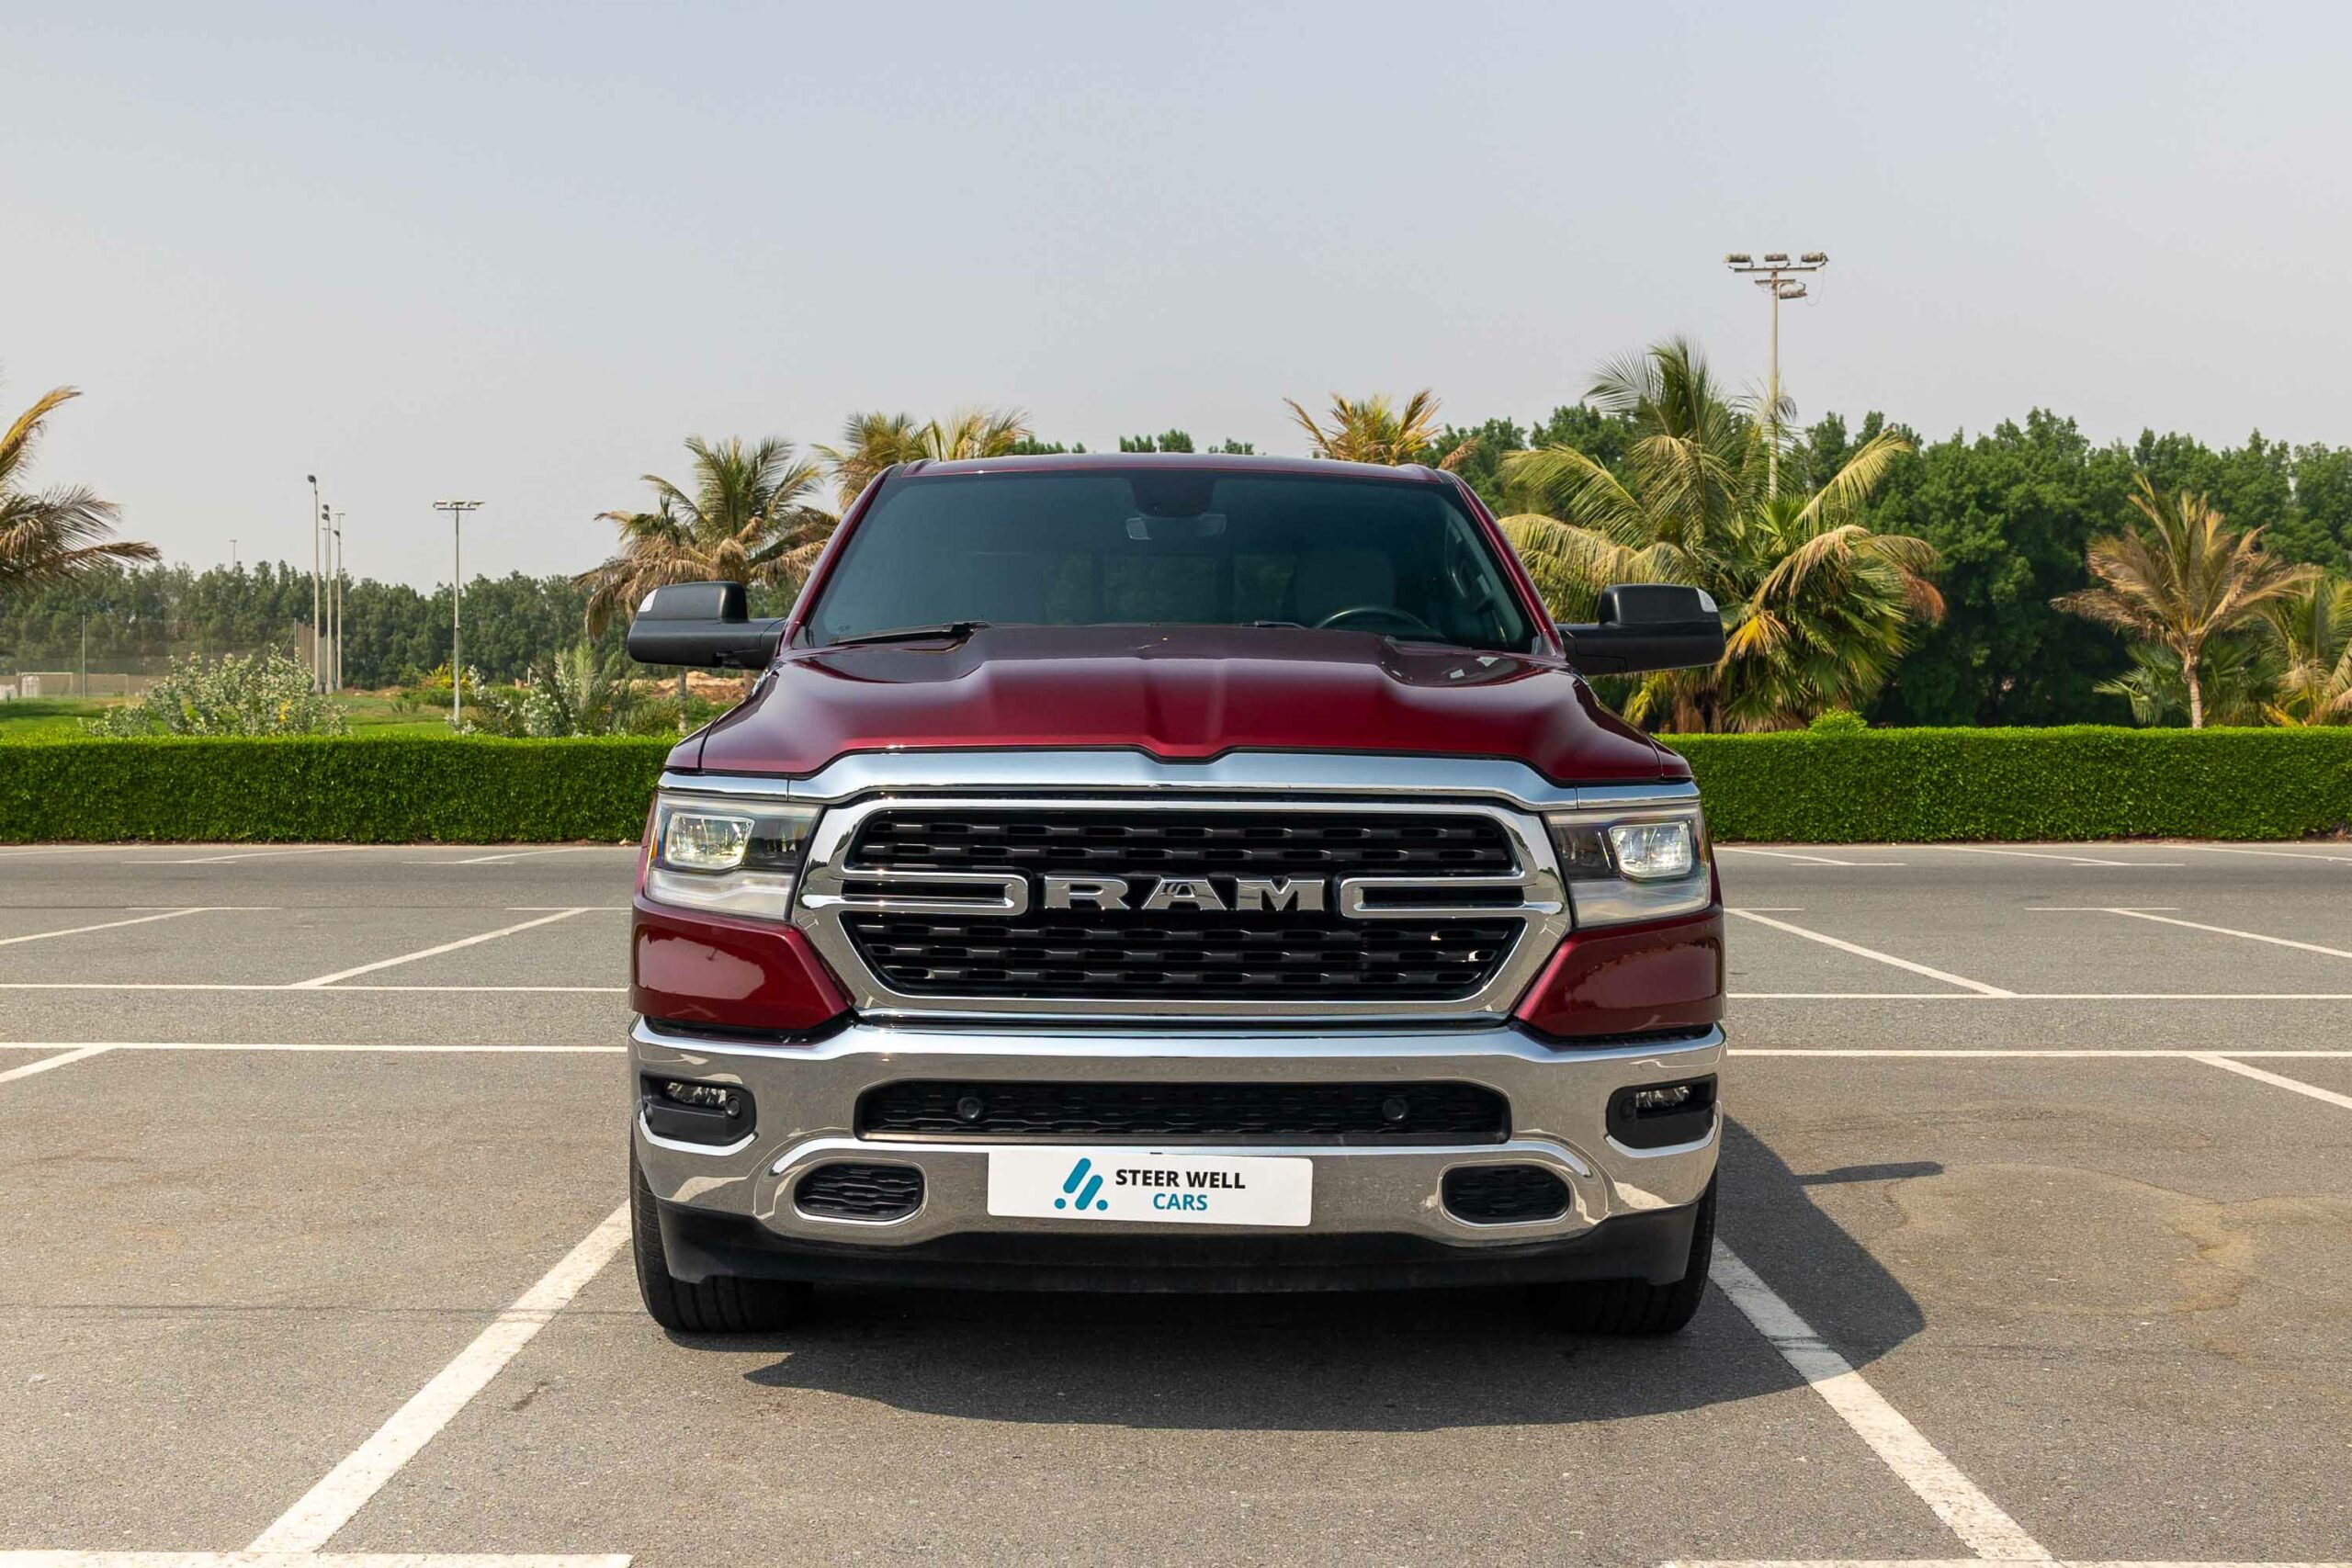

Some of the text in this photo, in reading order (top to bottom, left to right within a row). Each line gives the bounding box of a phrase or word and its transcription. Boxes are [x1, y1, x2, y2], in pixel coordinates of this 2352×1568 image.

[1044, 874, 1325, 911] RAM
[1114, 1168, 1246, 1190] STEER WELL
[1152, 1192, 1208, 1212] CARS
